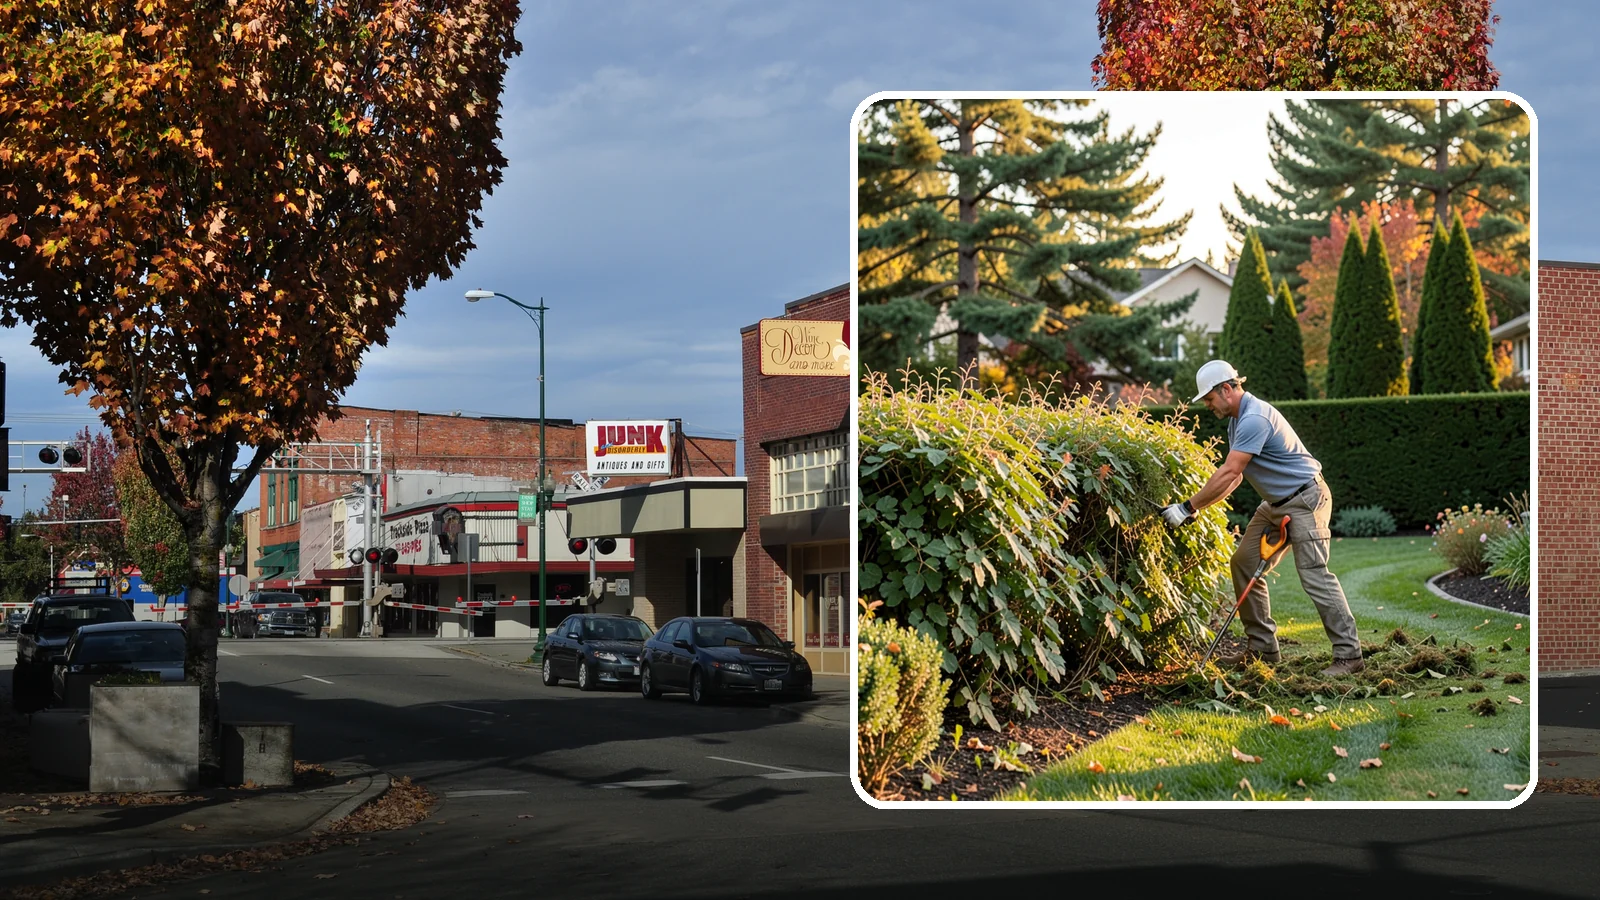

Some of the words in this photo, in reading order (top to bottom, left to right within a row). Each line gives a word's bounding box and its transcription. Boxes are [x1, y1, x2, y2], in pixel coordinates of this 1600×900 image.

[595, 425, 665, 457] JUNK
[607, 446, 646, 454] DISORDERLY
[596, 461, 628, 470] ANTIQUES
[631, 461, 643, 470] AND
[646, 460, 665, 469] GIFTS
[573, 473, 588, 491] RAIL
[590, 476, 608, 492] SING
[390, 521, 413, 540] Trackside
[414, 519, 429, 535] Pizza
